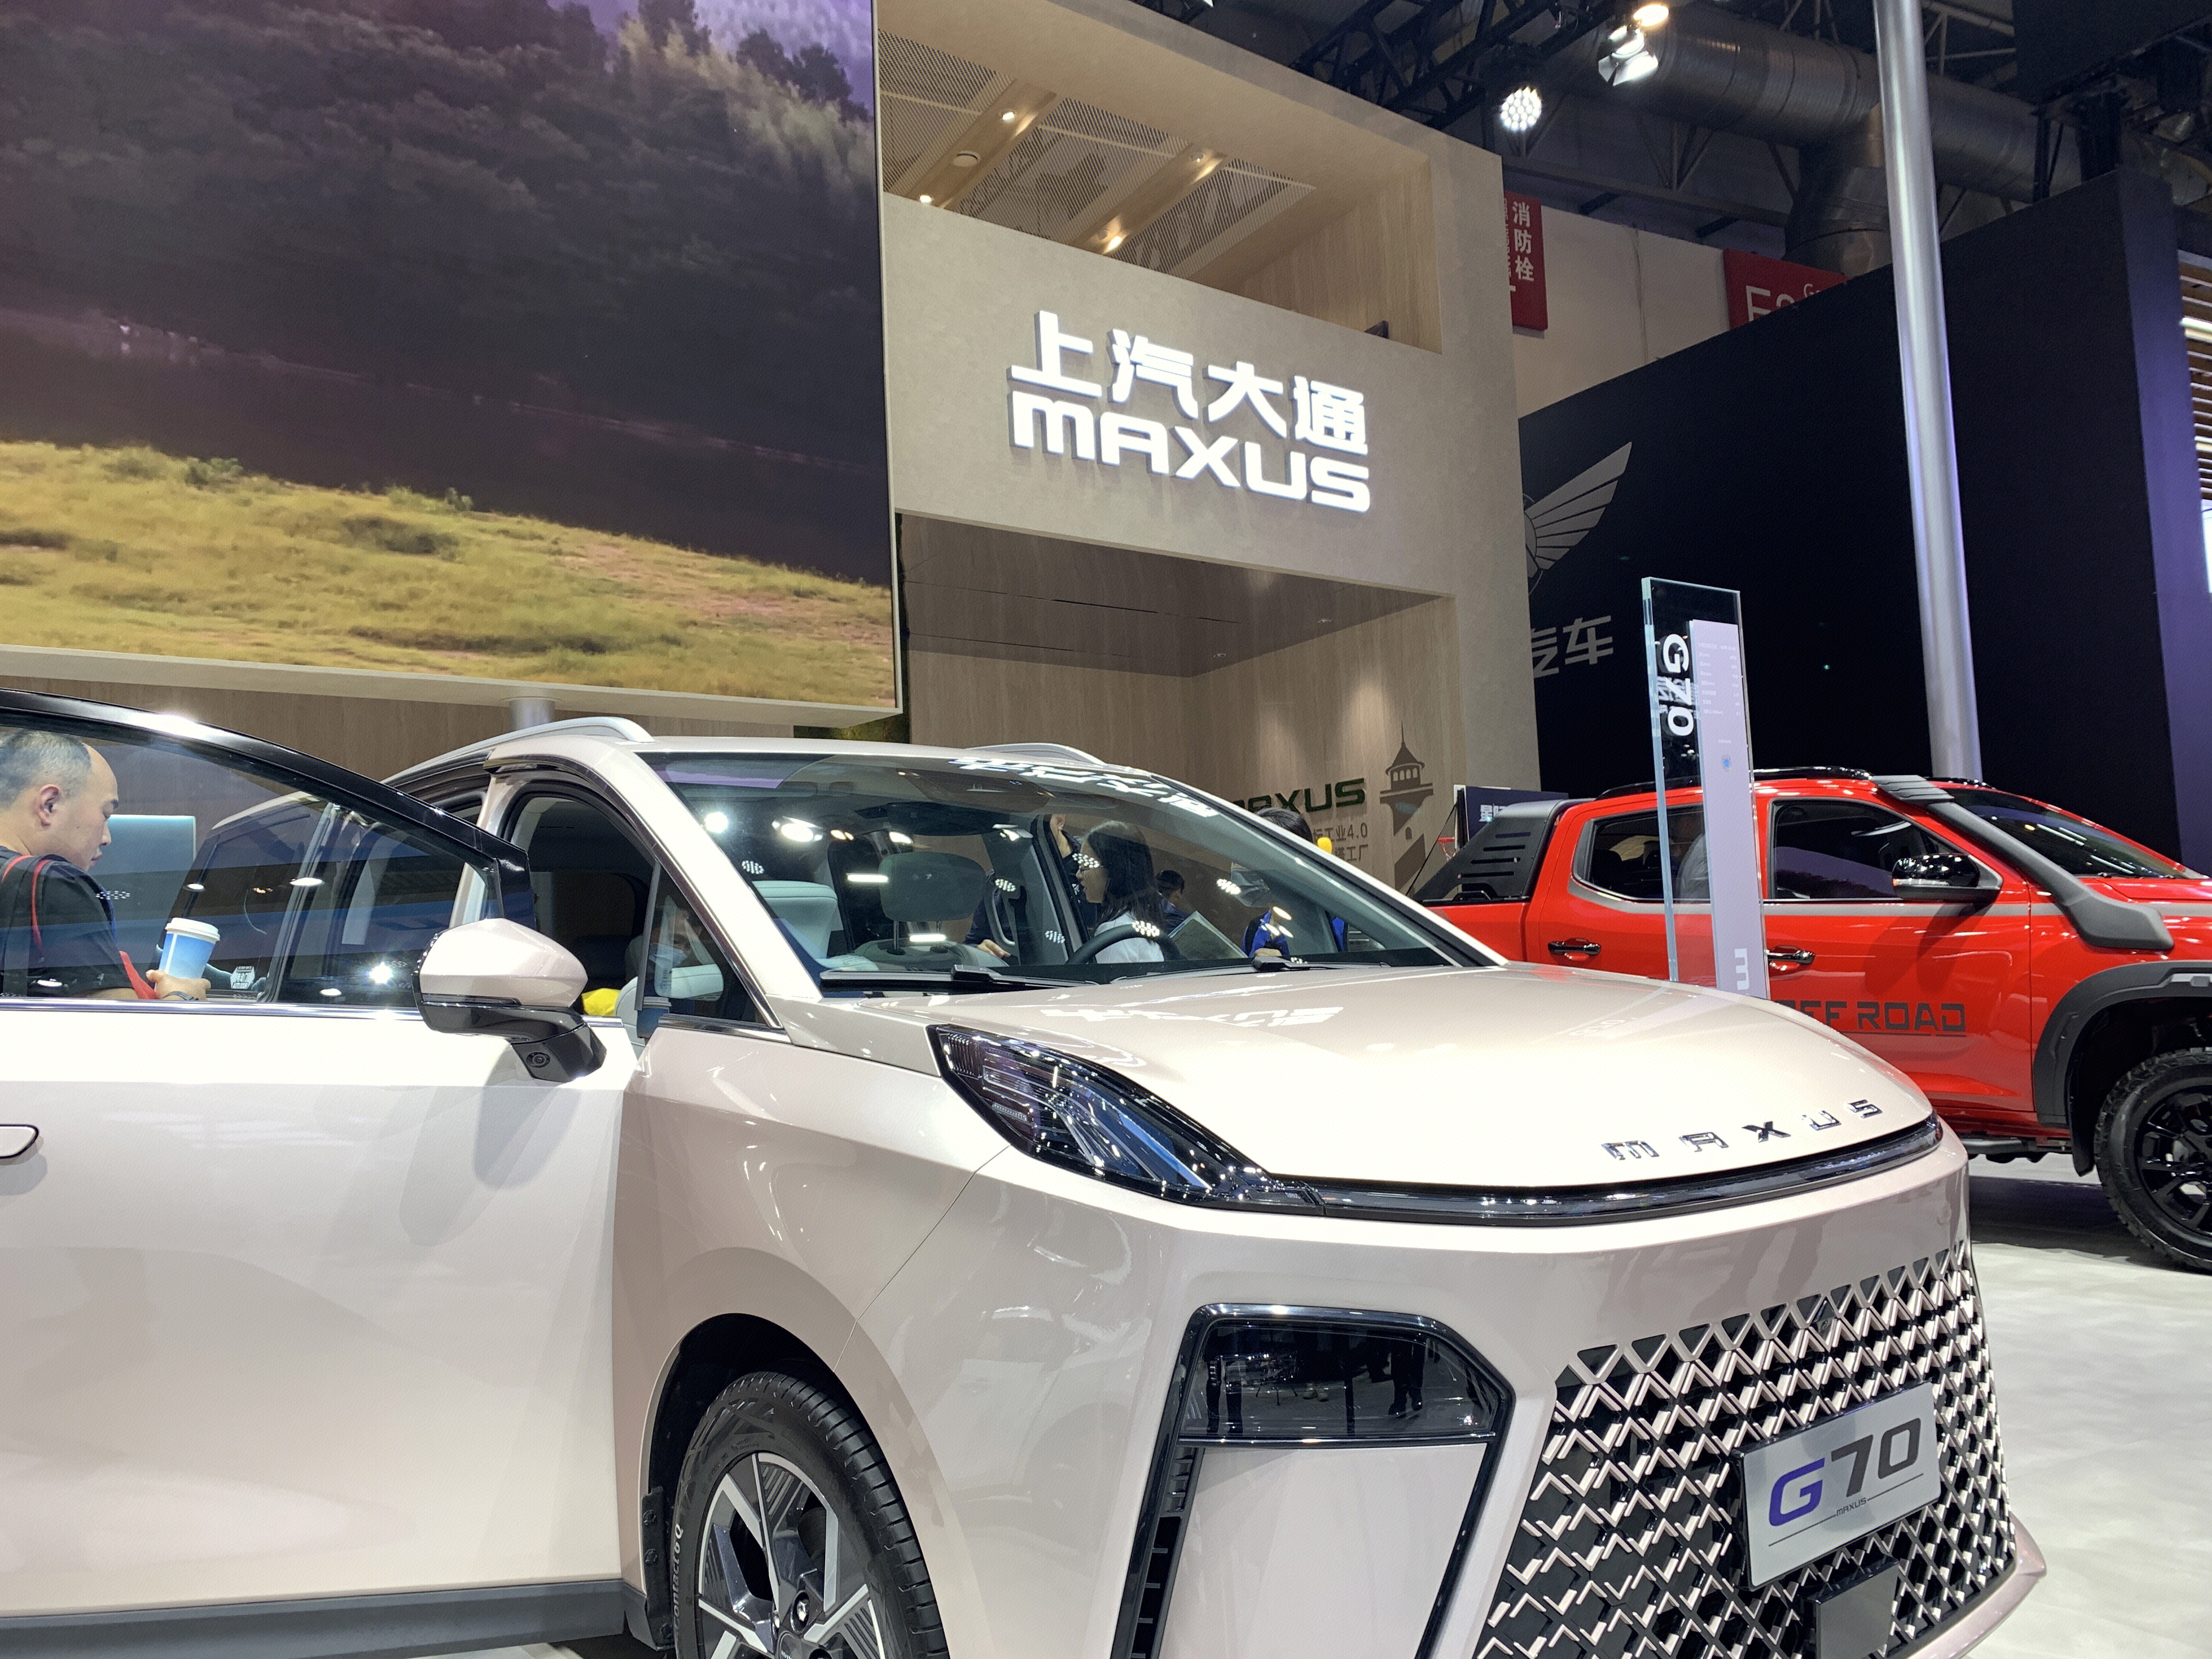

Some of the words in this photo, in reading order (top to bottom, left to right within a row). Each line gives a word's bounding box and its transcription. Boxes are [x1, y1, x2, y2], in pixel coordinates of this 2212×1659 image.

[1513, 201, 1534, 281] 消防栓
[1007, 310, 1368, 455] 上汽大通
[1008, 390, 1370, 512] MAXUS
[1663, 634, 1694, 736] G70
[1232, 778, 1365, 814] AXUS
[1857, 1001, 1966, 1032] ROAD
[1601, 1099, 1883, 1161] MAXUS
[1768, 1417, 1921, 1527] G70
[1836, 1497, 1867, 1516] MAXUS
